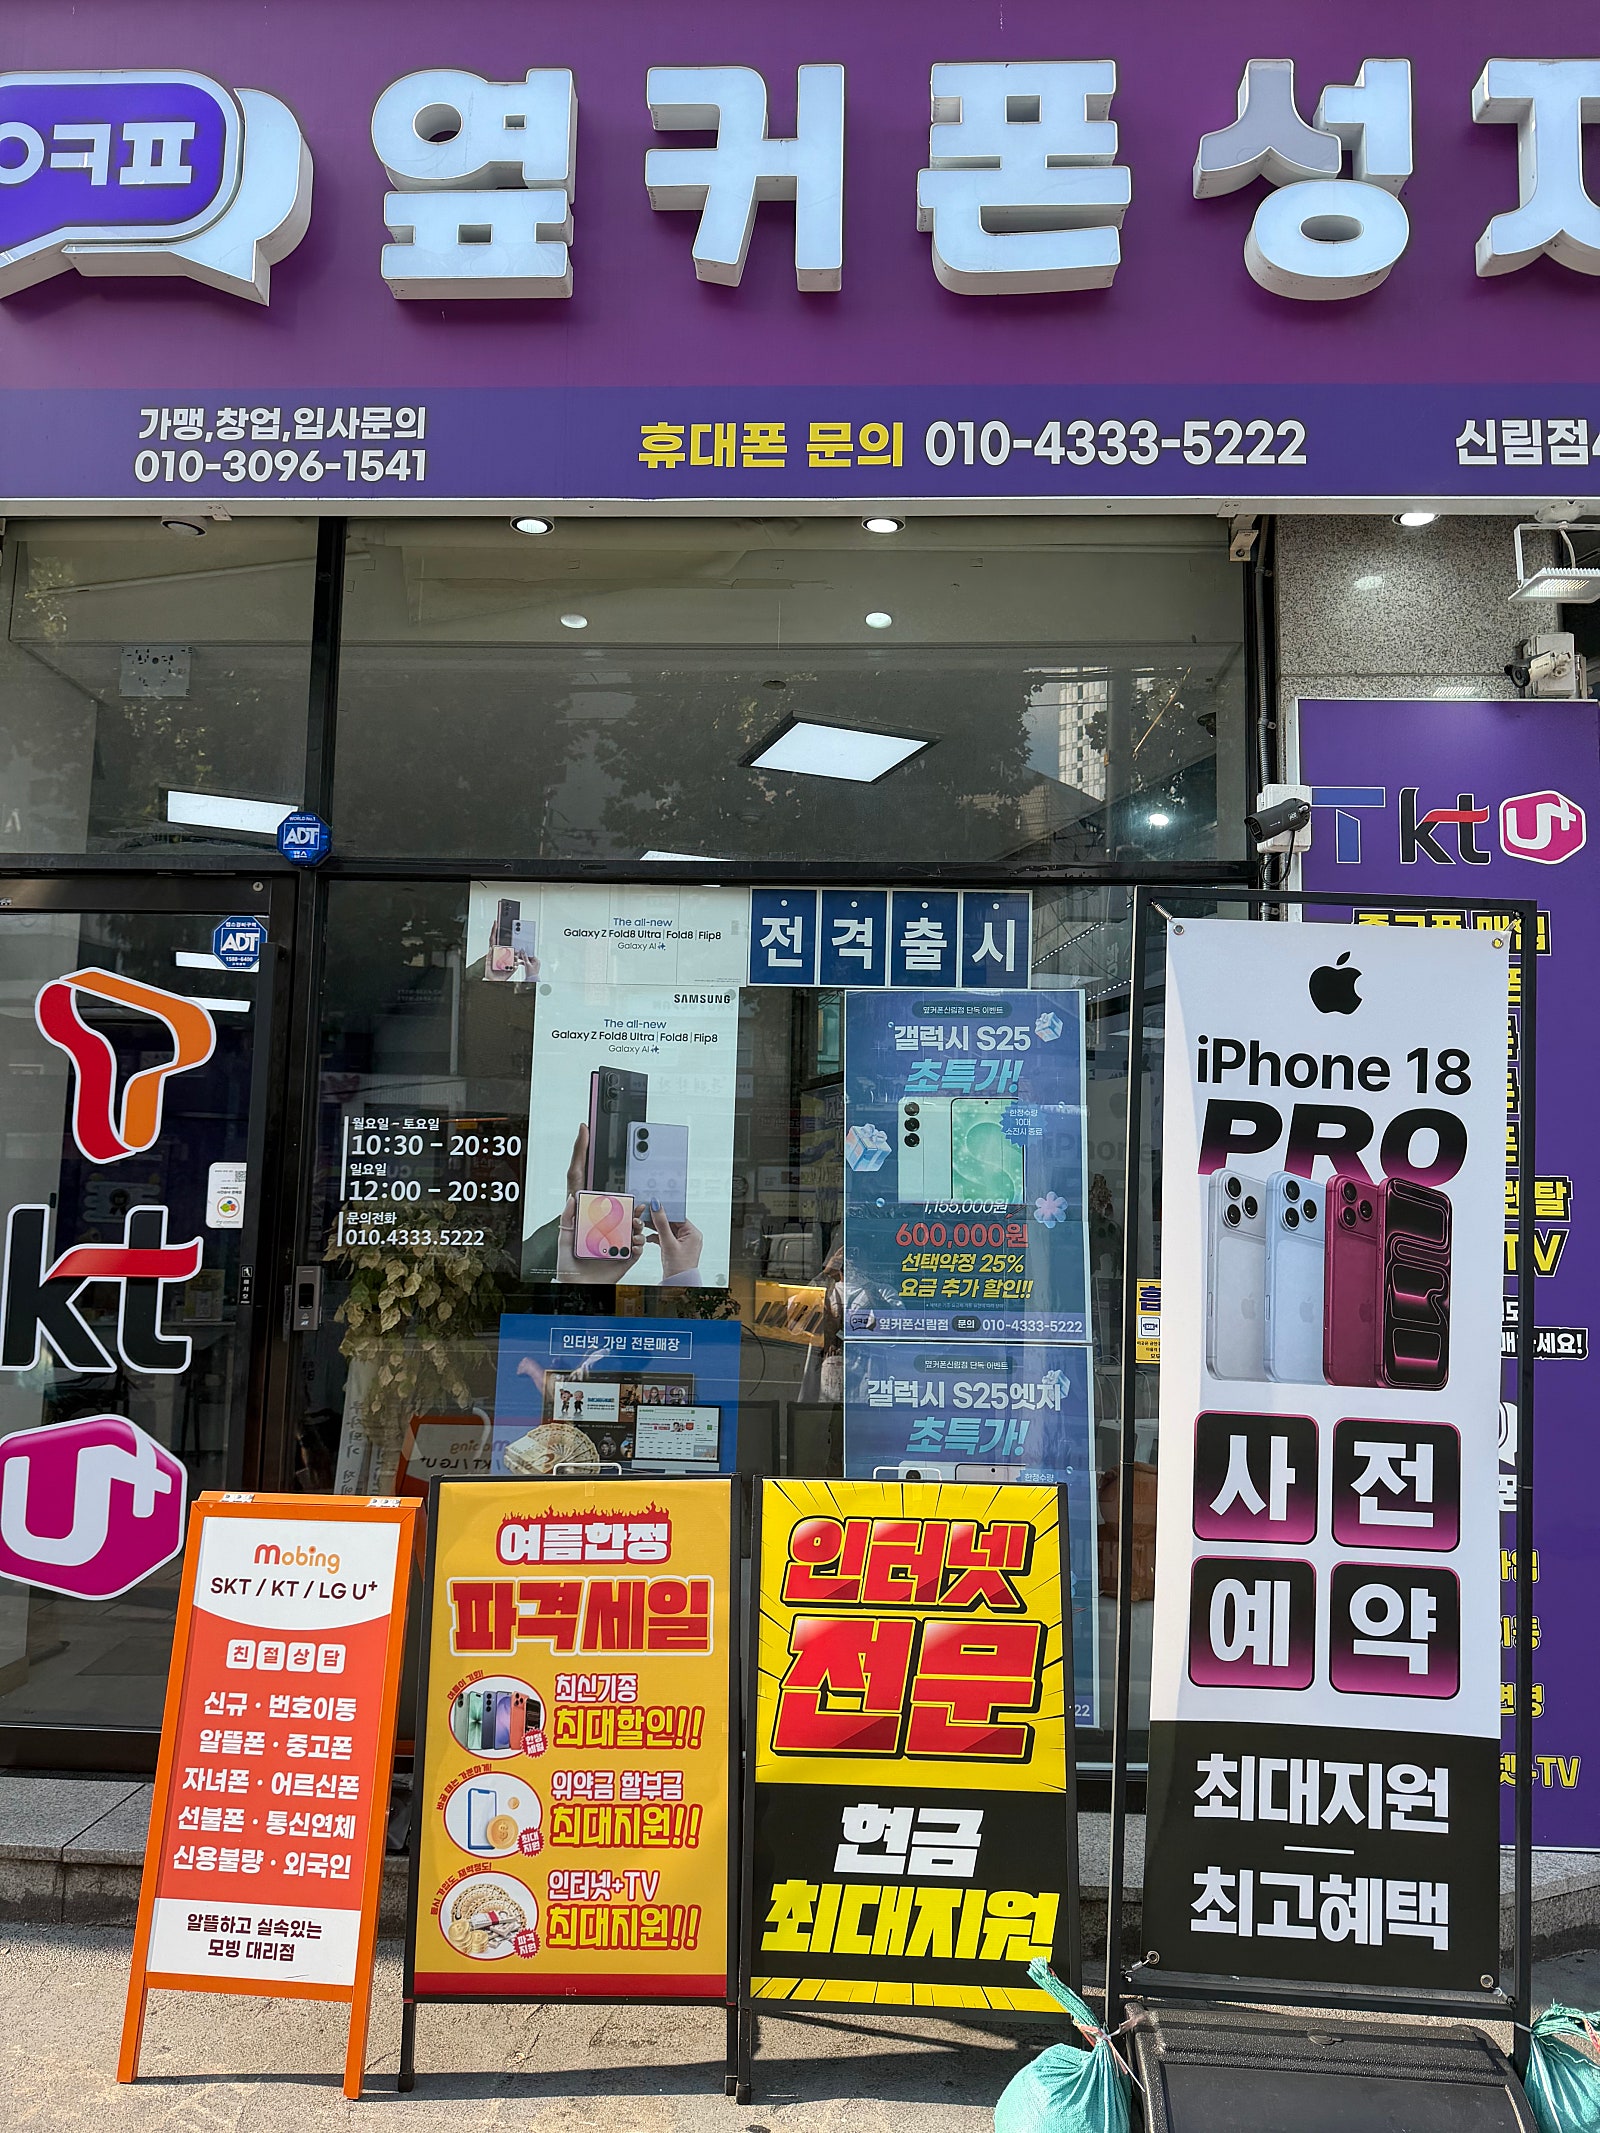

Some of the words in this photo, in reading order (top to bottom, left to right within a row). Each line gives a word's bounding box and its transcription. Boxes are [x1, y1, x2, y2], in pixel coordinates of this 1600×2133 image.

[138, 407, 426, 442] 가맹,창업,입사문의
[638, 421, 788, 470] 휴대폰
[806, 420, 903, 468] 문의
[925, 420, 1306, 467] 010-4333-5222
[134, 449, 426, 483] 010-3096-1541
[284, 827, 319, 845] ADT
[1400, 787, 1492, 865] kt
[564, 928, 600, 939] Galaxy
[601, 930, 607, 938] Z
[609, 929, 635, 939] Fold8
[638, 930, 661, 939] Ultra
[666, 930, 693, 940] Fold8
[698, 930, 721, 941] Flip8
[613, 917, 631, 927] The
[633, 917, 672, 928] all-new
[221, 933, 259, 951] ADT
[618, 942, 647, 951] Galaxy
[649, 942, 657, 950] AI
[760, 916, 1015, 972] 전격출시
[674, 994, 731, 1004] SAMSUNG
[551, 1030, 589, 1041] Galaxy
[591, 1031, 597, 1040] Z
[599, 1031, 627, 1040] Fold8
[630, 1031, 654, 1041] Ultra
[660, 1032, 688, 1042] Fold8
[694, 1033, 718, 1044] Flip8
[604, 1019, 623, 1029] The
[626, 1019, 666, 1029] all-new
[894, 1025, 969, 1051] 갤럭시
[976, 1026, 1031, 1051] S25
[608, 1044, 639, 1054] Galaxy
[642, 1045, 650, 1053] AI
[904, 1059, 1024, 1094] 초특가!
[1197, 1034, 1391, 1092] iPhone
[1406, 1047, 1472, 1096] 18
[351, 1117, 389, 1131] 월요일
[402, 1117, 440, 1131] 토요일
[351, 1135, 424, 1156] 10:30
[449, 1135, 522, 1156] 20:30
[1197, 1098, 1468, 1187] PRO
[350, 1163, 387, 1176] 일요일
[349, 1180, 422, 1201] 12:00
[447, 1181, 520, 1202] 20:30
[346, 1212, 397, 1225] 문의전화
[345, 1229, 485, 1246] 010.4333.5222
[895, 1223, 1029, 1249] 600,000원
[901, 1253, 976, 1273] 선택약정
[978, 1254, 1025, 1273] 25%
[0, 1204, 204, 1374] kt
[898, 1278, 938, 1298] 요금
[940, 1279, 980, 1298] 추가
[983, 1279, 1033, 1299] 할인!!
[879, 1319, 949, 1331] 옆커폰신림점
[958, 1319, 976, 1329] 문의
[982, 1318, 1083, 1333] 010-4333-5222
[562, 1334, 600, 1350] 인터넷
[603, 1335, 628, 1351] 가입
[631, 1336, 681, 1353] 전문매장
[867, 1380, 945, 1409] 갤럭시
[952, 1382, 1061, 1411] S25엣지
[906, 1416, 1030, 1456] 초특가!
[499, 1521, 670, 1562] 여름한정
[783, 1518, 1033, 1609] 인터넷
[210, 1577, 252, 1595] SKT
[271, 1580, 300, 1597] KT
[319, 1582, 347, 1599] LG
[450, 1578, 711, 1654] 파격세일
[554, 1674, 638, 1703] 최신기종
[773, 1617, 1043, 1758] 전문
[204, 1692, 248, 1716] 신규
[269, 1694, 357, 1722] 번호이동
[554, 1707, 704, 1749] 최대할인!!
[199, 1729, 266, 1756] 알뜰폰
[286, 1733, 353, 1760] 중고폰
[182, 1767, 250, 1795] 자녀폰
[271, 1772, 360, 1800] 어르신폰
[552, 1771, 614, 1800] 위약금
[620, 1772, 683, 1800] 할부금
[1194, 1753, 1449, 1835] 최대지원
[178, 1806, 245, 1833] 선불폰
[266, 1810, 356, 1840] 통신연체
[521, 1831, 539, 1843] 최대
[552, 1805, 702, 1847] 최대지원!!
[523, 1842, 541, 1853] 지원
[833, 1804, 984, 1878] 현금
[173, 1845, 264, 1874] 신용불량
[283, 1852, 352, 1879] 외국인
[549, 1871, 660, 1901] 인터넷+TV
[760, 1879, 1060, 1963] 최대지원
[1190, 1865, 1449, 1951] 최고혜택
[187, 1913, 252, 1935] 알뜰하고
[257, 1918, 322, 1939] 실속있는
[517, 1932, 535, 1945] 파격
[548, 1906, 702, 1949] 최대지원!!
[207, 1939, 241, 1958] 모빙
[245, 1941, 295, 1962] 대리점
[519, 1943, 537, 1955] 지원
